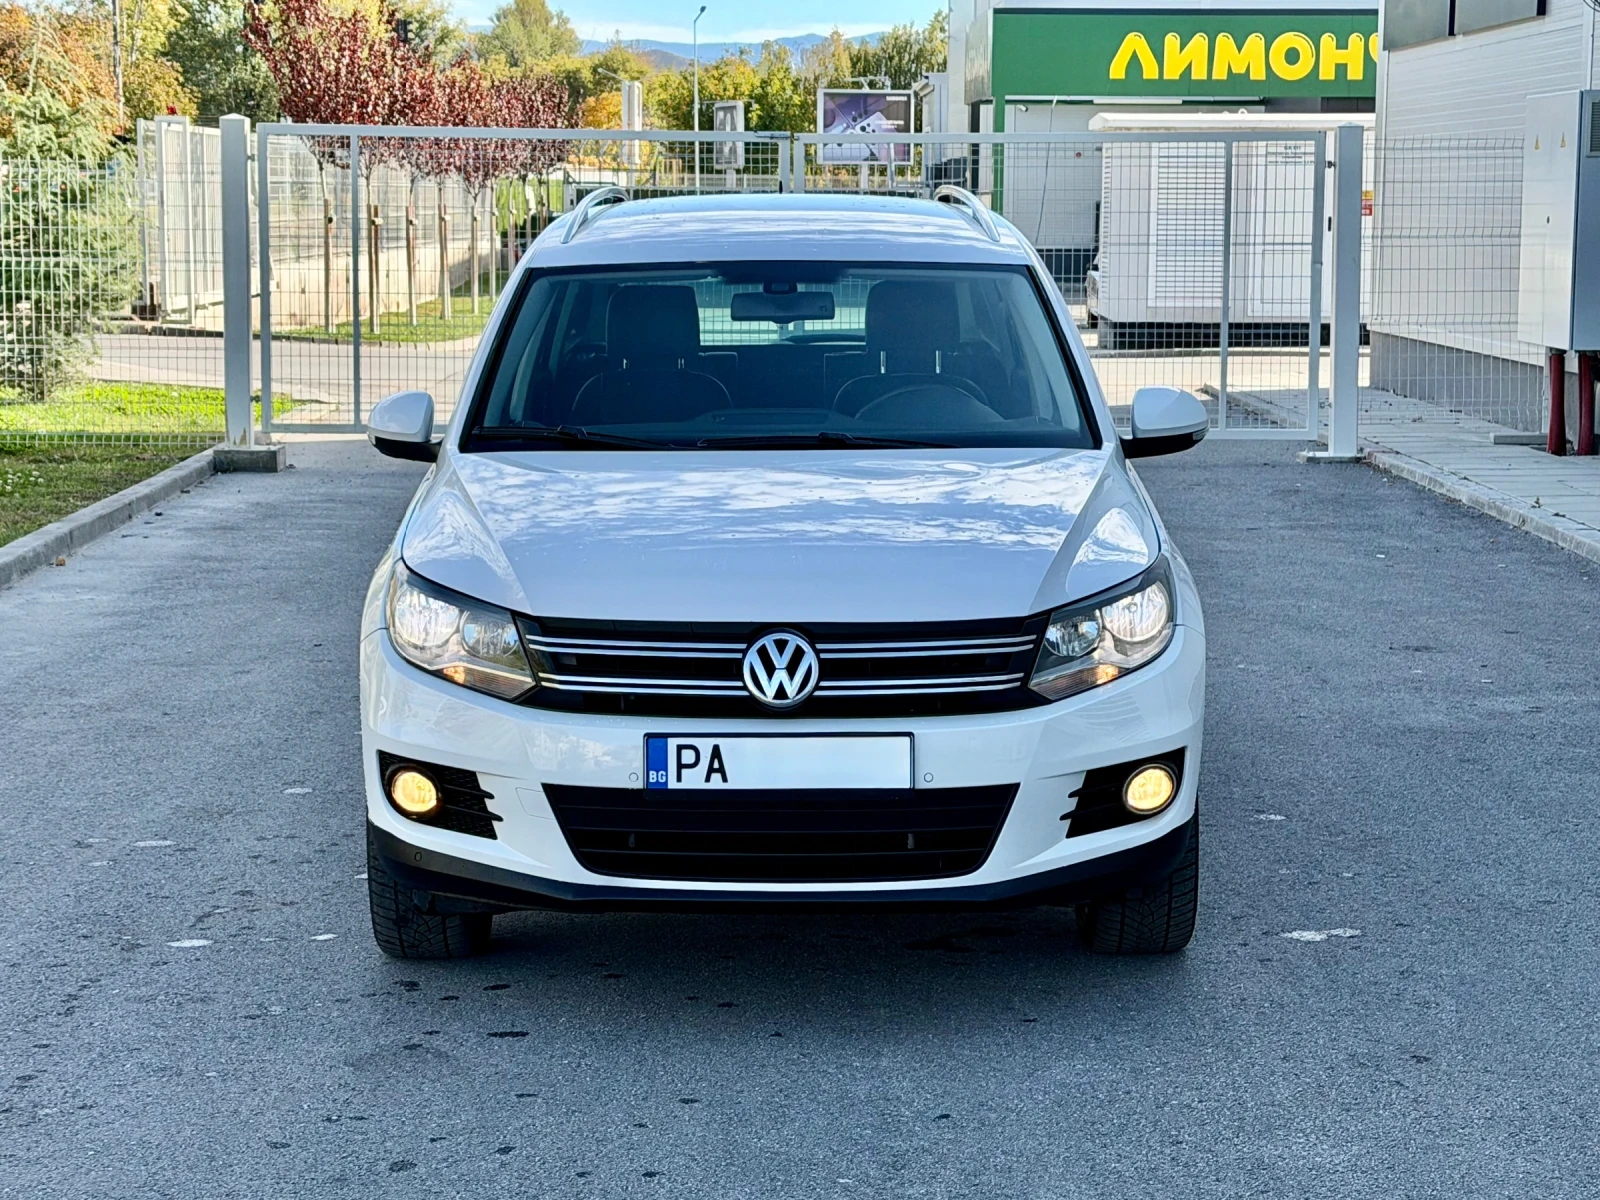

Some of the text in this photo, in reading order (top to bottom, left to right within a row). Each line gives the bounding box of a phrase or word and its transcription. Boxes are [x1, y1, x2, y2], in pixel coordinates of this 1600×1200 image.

[1109, 32, 1378, 81] ЛИМОН
[743, 633, 819, 703] VW
[649, 770, 666, 783] BG
[676, 744, 729, 783] PA
